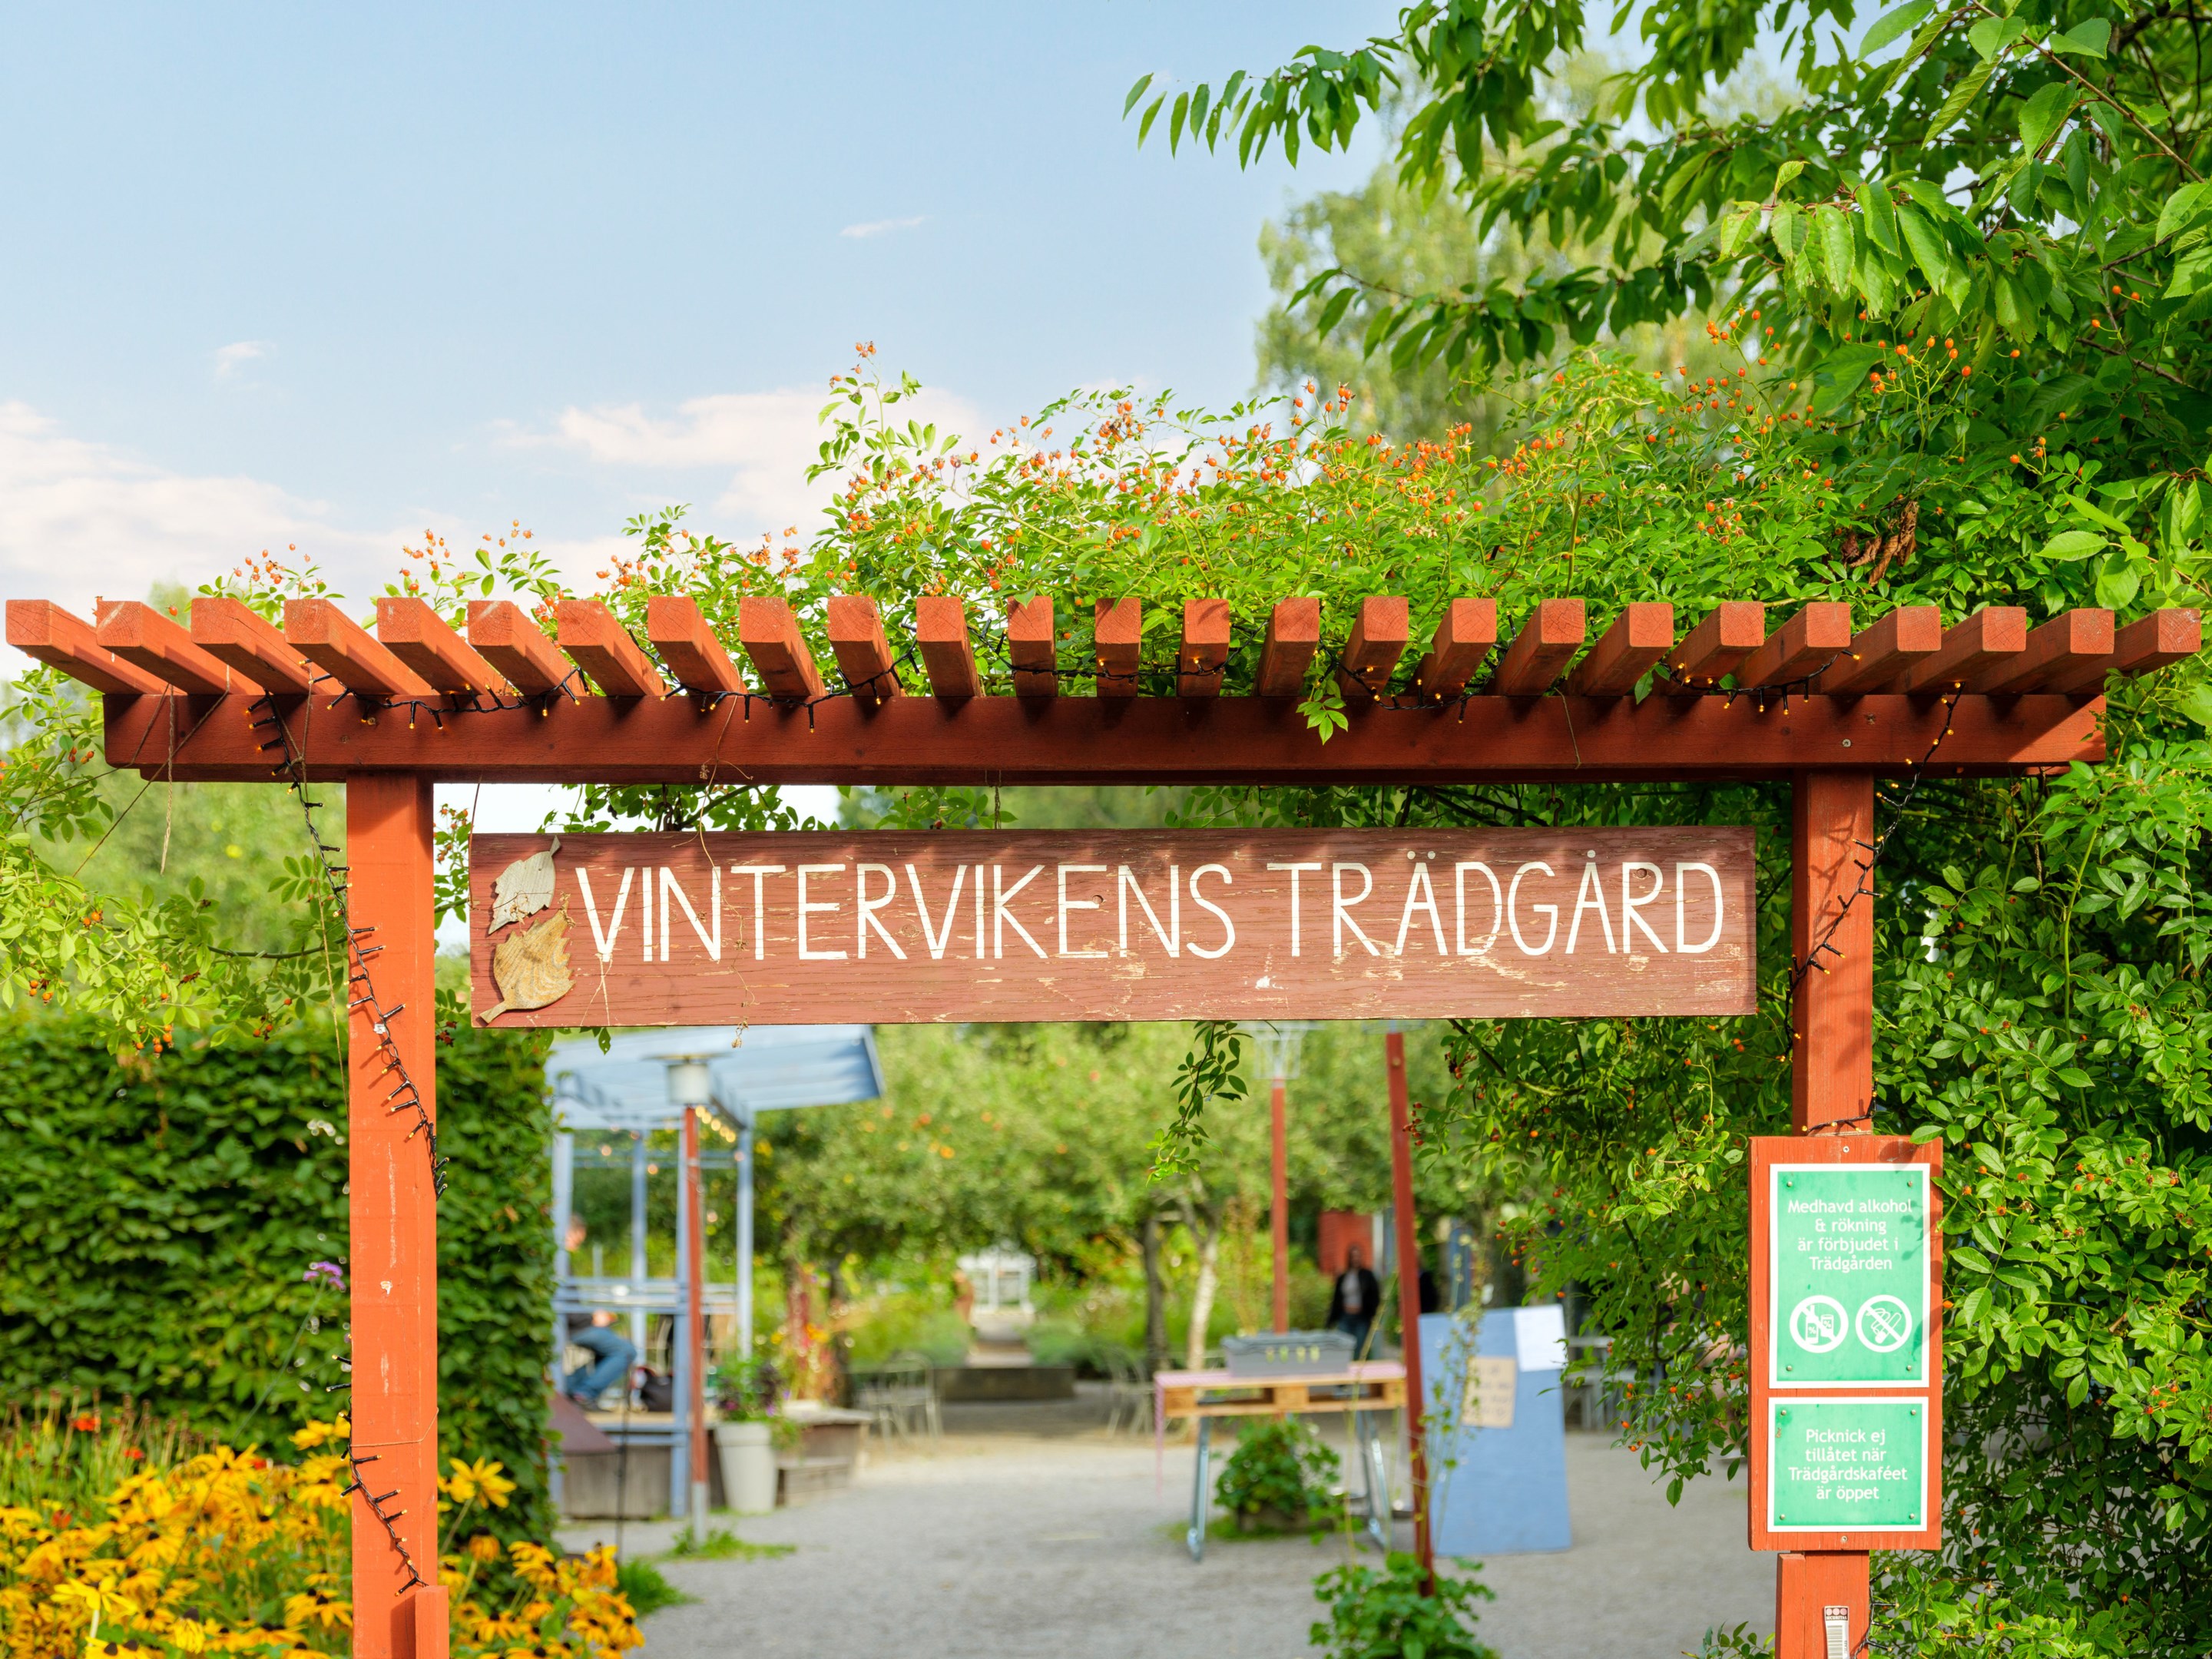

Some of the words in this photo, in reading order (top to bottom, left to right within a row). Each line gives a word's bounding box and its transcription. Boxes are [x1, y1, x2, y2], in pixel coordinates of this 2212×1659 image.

[575, 863, 1237, 963] VINTERVIKENS
[1267, 849, 1724, 958] TRÄDGÅRD
[1787, 1199, 1854, 1214] Medhavd
[1859, 1198, 1912, 1214] alkohol
[1814, 1218, 1826, 1232] &
[1831, 1217, 1887, 1234] rökning
[1797, 1237, 1814, 1252] är
[1818, 1237, 1889, 1253] förbjudet
[1893, 1237, 1899, 1251] i
[1809, 1254, 1892, 1273] Trädgården
[1806, 1428, 1866, 1443] Picknick
[1870, 1429, 1886, 1445] ej
[1805, 1445, 1857, 1462] tillåtet
[1862, 1447, 1886, 1462] när
[1788, 1465, 1907, 1484] Trädgårdskaféet
[1816, 1485, 1832, 1499] är
[1836, 1485, 1879, 1503] öppet
